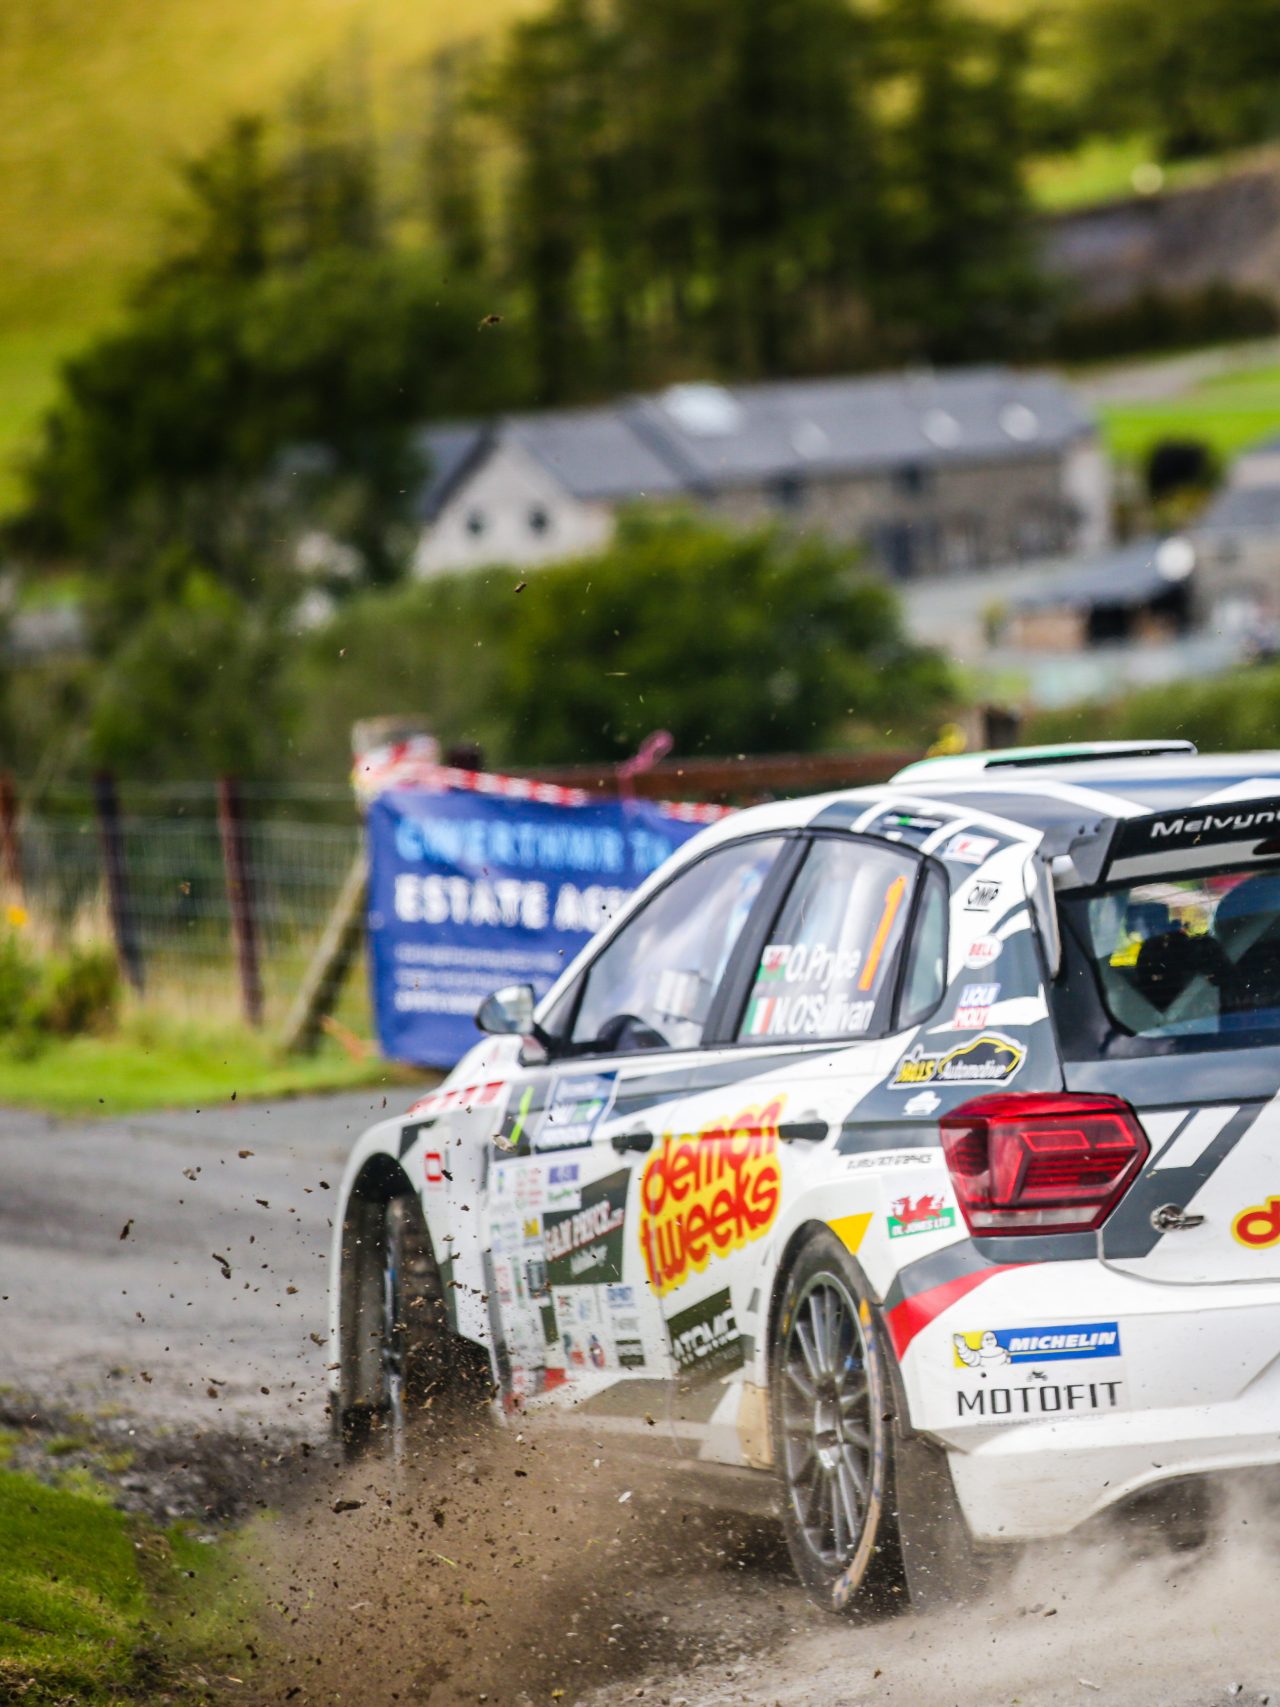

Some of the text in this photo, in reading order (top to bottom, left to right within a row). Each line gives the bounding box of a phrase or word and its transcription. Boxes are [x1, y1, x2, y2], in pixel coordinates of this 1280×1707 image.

[395, 873, 550, 930] ESTATE
[968, 943, 994, 957] BELL
[642, 1096, 783, 1217] demon
[641, 1160, 779, 1288] tweeks
[1008, 1331, 1117, 1352] MICHELIN
[956, 1380, 1124, 1417] MOTOFIT
